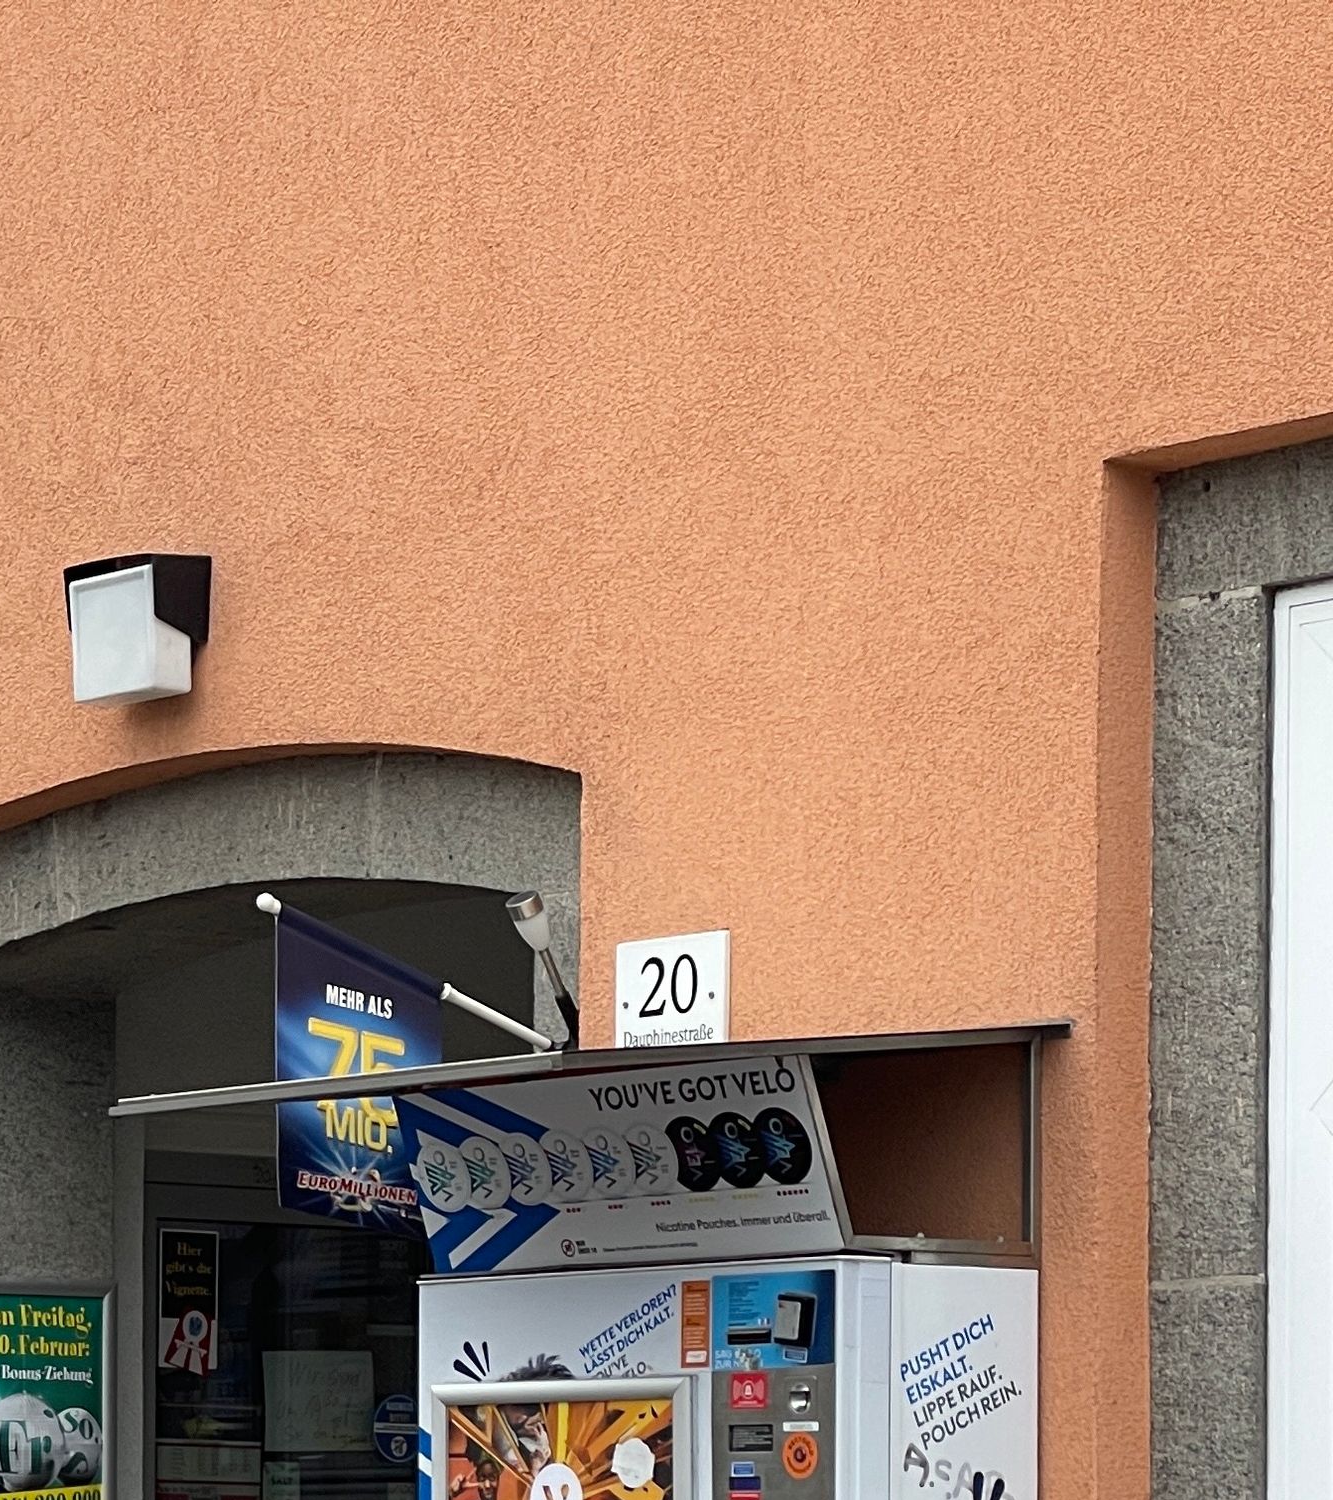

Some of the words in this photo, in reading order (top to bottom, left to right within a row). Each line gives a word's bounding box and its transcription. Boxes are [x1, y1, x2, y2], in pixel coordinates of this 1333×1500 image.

[325, 983, 365, 1013] MEHR
[366, 991, 393, 1020] ALS
[638, 952, 699, 1019] 20
[623, 1023, 714, 1048] Dauphinestraße
[588, 1080, 676, 1112] YOU'VE
[678, 1074, 727, 1103] GOT
[731, 1067, 796, 1096] VELO
[297, 1170, 419, 1206] EUROMILLIONEN
[656, 1219, 696, 1233] Nicotine
[740, 1213, 772, 1227] Immer
[774, 1212, 792, 1225] und
[793, 1210, 831, 1223] überall.
[177, 1242, 204, 1257] Hier
[196, 1262, 213, 1275] die
[165, 1281, 213, 1297] Vignette.
[19, 1303, 92, 1338] Freitag,
[579, 1322, 618, 1357] WETTE
[614, 1284, 678, 1333] VERLOREN?
[19, 1334, 90, 1357] Februar:
[583, 1343, 618, 1374] LÄSST
[616, 1325, 645, 1352] DICH
[643, 1306, 675, 1335] KALT.
[900, 1338, 950, 1382] PUSHT
[952, 1313, 994, 1351] DICH
[1, 1364, 93, 1388] Bonus-Ziehung
[906, 1355, 973, 1405] EISKALT.
[913, 1390, 958, 1428] LIPPE
[958, 1364, 1003, 1404] RAUF.
[921, 1402, 981, 1450] POUCH
[982, 1380, 1023, 1417] REIN.
